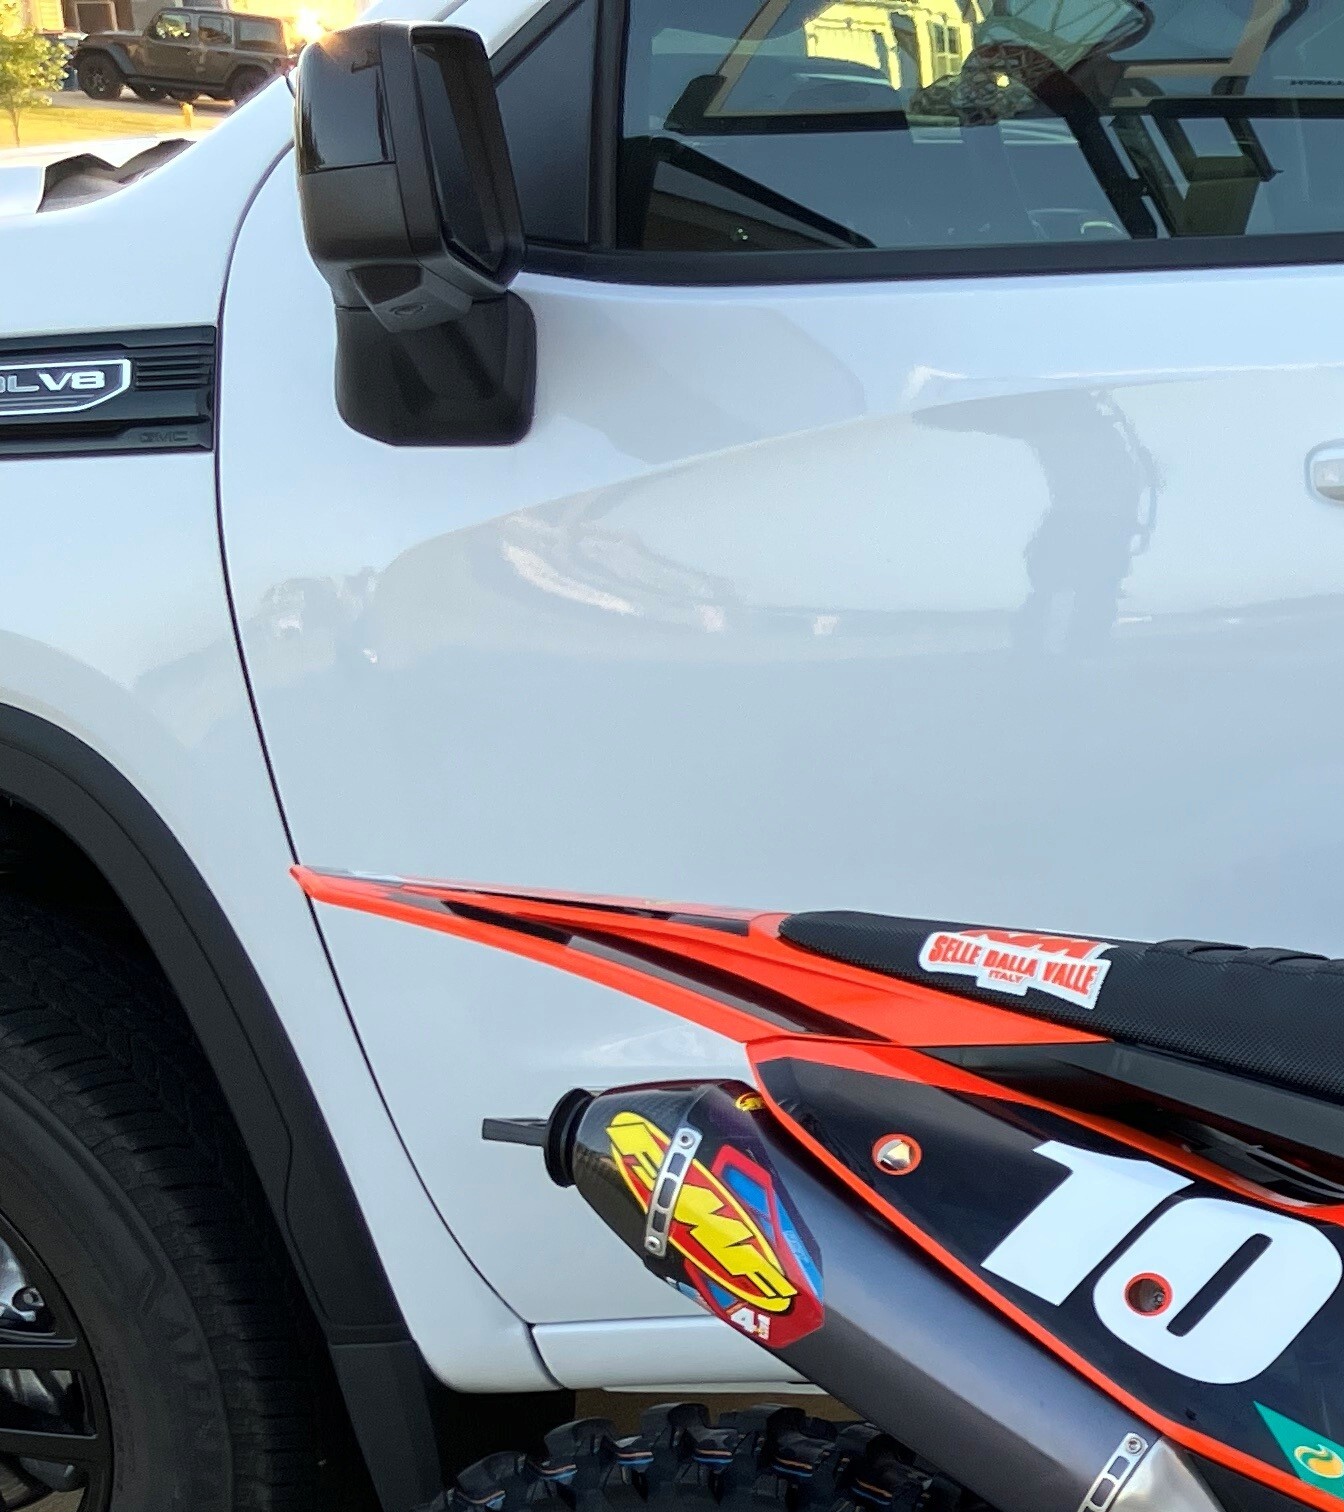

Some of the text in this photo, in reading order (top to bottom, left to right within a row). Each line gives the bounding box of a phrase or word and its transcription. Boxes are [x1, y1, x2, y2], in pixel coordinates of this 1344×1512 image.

[0, 370, 105, 393] LV8
[927, 935, 982, 966] SELLE
[983, 949, 1039, 977] DALLA
[1039, 961, 1098, 995] VALLE
[988, 969, 1024, 984] ITALY
[980, 1140, 1343, 1384] 10
